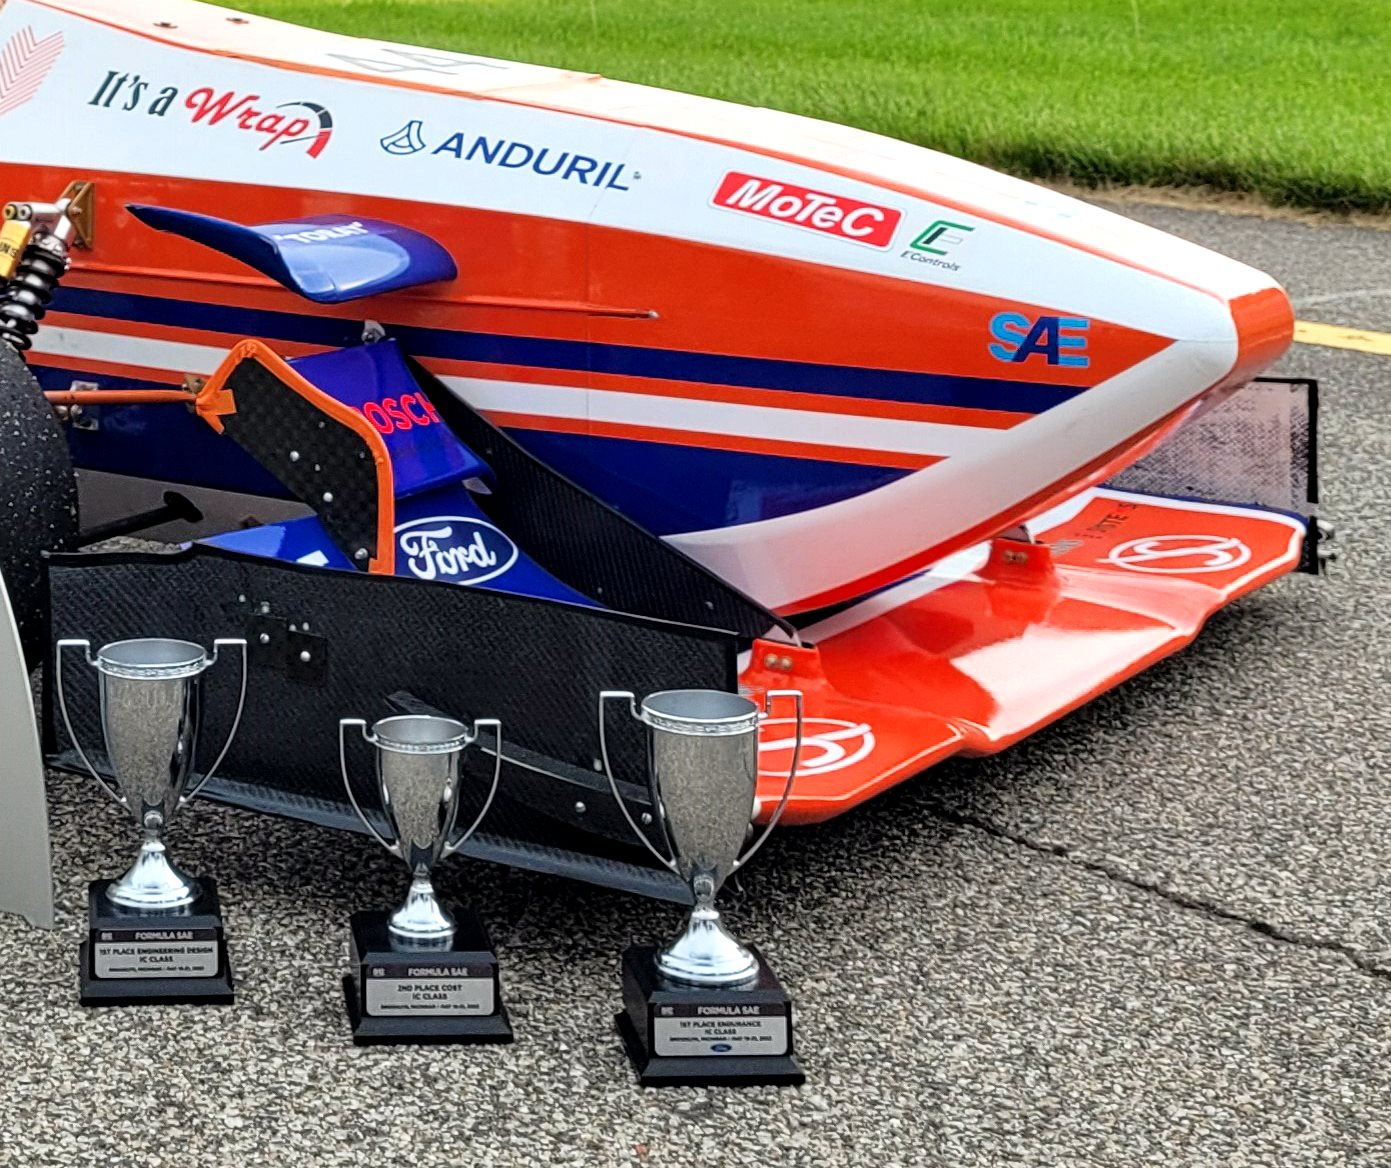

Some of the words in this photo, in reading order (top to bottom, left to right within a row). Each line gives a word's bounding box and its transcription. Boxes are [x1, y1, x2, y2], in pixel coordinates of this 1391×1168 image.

[87, 70, 149, 112] It's
[147, 86, 178, 117] a
[184, 87, 310, 152] Wrap
[431, 132, 629, 191] ANDURIL
[725, 178, 885, 237] MoTeC
[988, 311, 1092, 368] SAE
[351, 392, 440, 435] OSCH
[400, 526, 498, 581] Ford
[113, 947, 135, 955] PLACE
[135, 931, 176, 940] FORMULA
[408, 967, 450, 976] FORMULA
[414, 984, 440, 992] PLACE
[441, 984, 463, 992] COST
[697, 1006, 741, 1015] FORMULA
